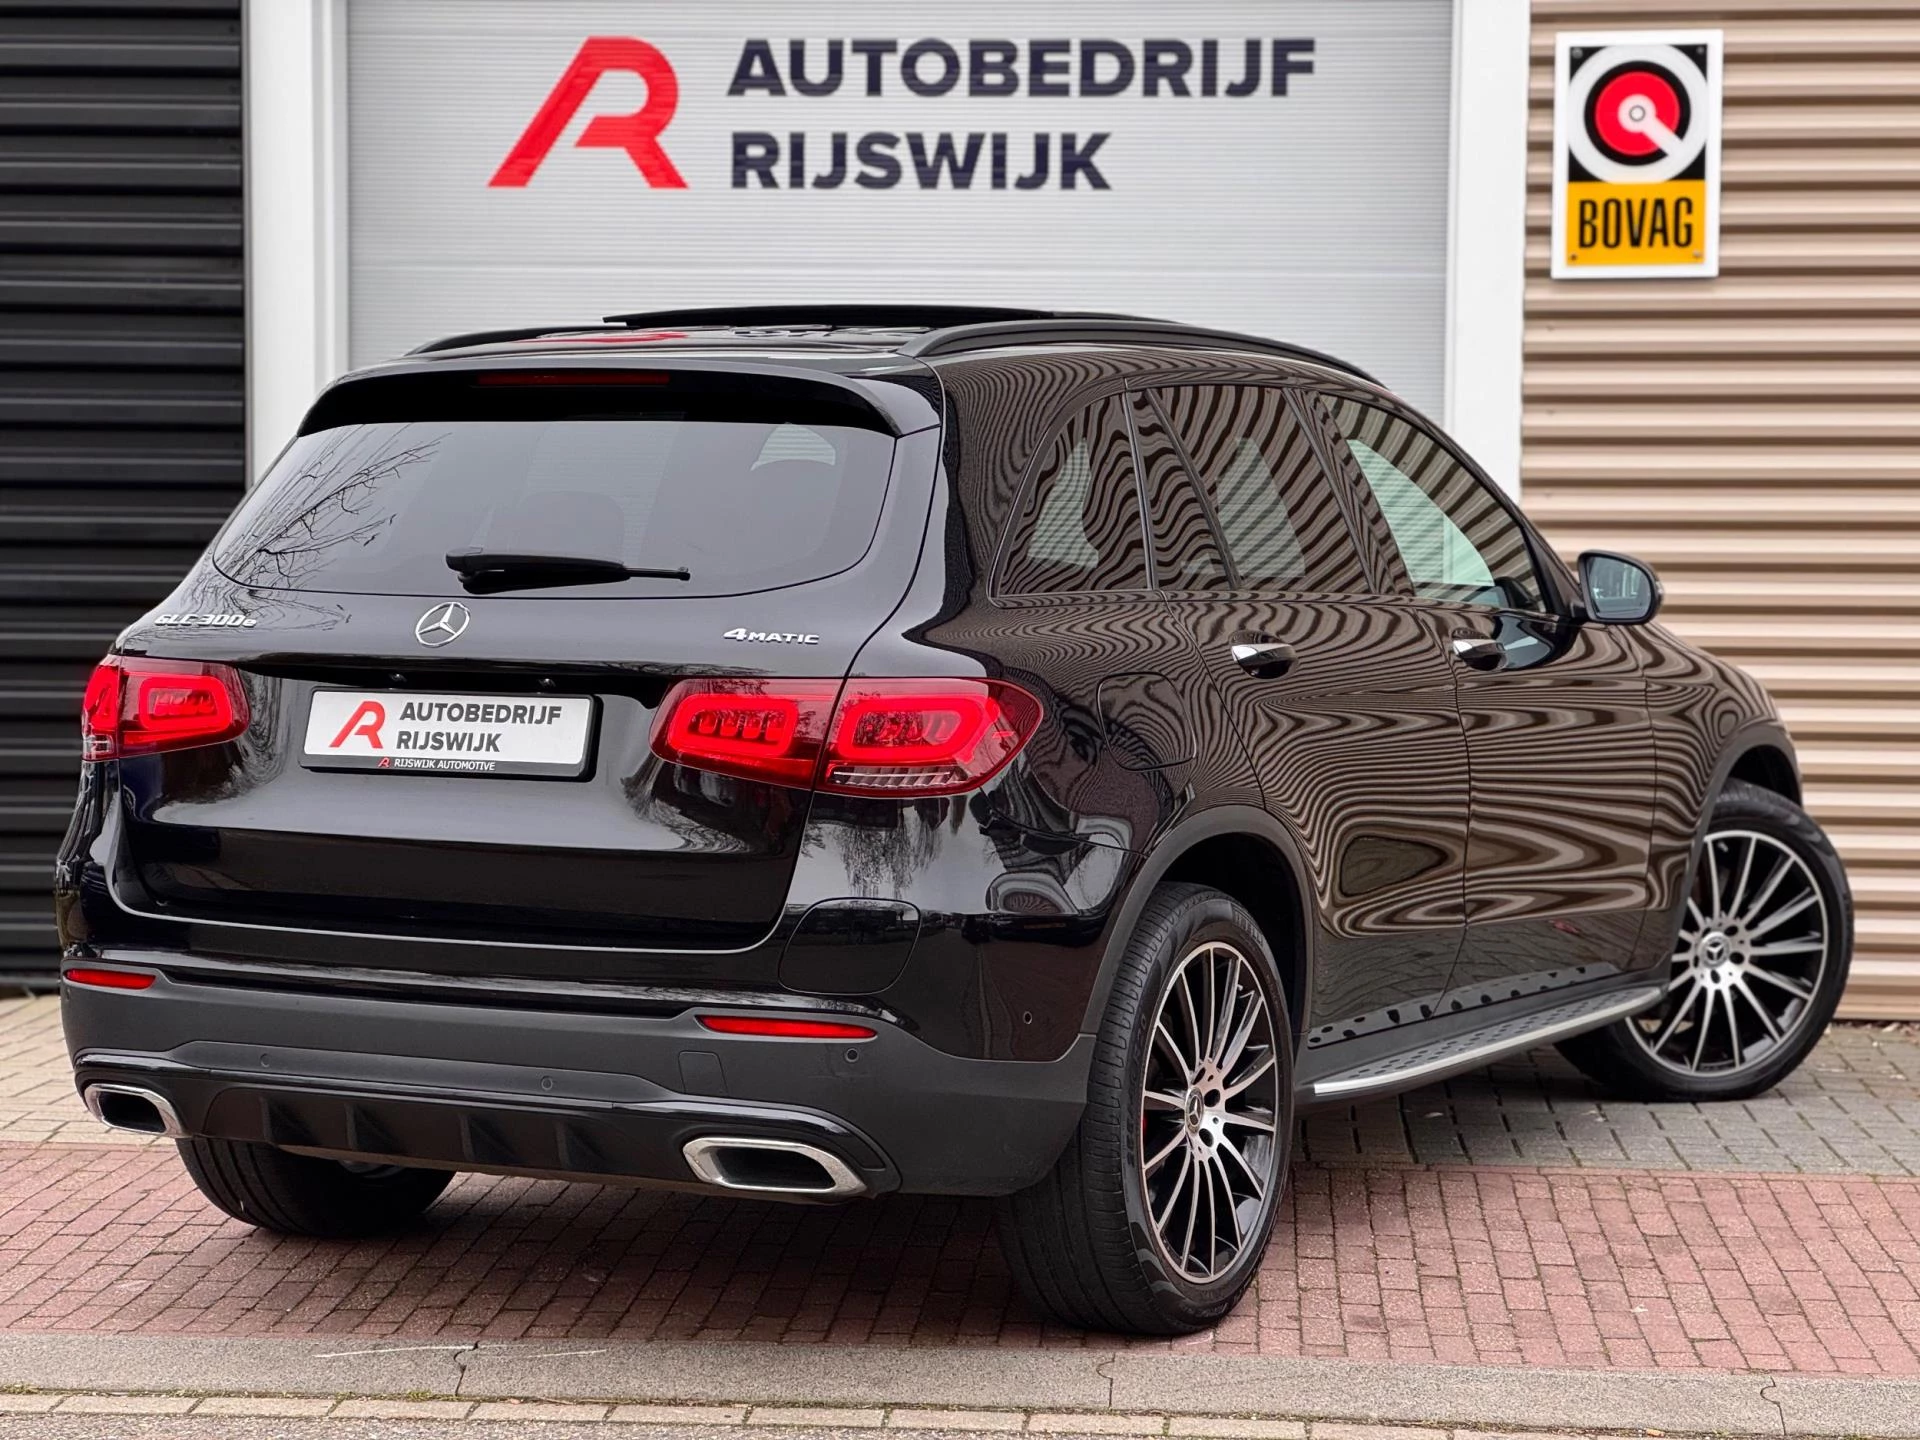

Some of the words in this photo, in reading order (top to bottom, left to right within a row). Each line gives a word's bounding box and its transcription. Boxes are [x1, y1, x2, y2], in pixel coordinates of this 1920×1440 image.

[727, 38, 1315, 98] AUTOBEDRIJF
[730, 131, 1113, 191] RIJSWIJK
[1578, 197, 1693, 249] BOVAG
[154, 613, 199, 627] GLC
[195, 614, 257, 629] 300e
[723, 627, 820, 645] 4MATIC
[399, 702, 562, 725] AUTOBEDRIJF
[396, 730, 502, 753] RIJSWIJK
[393, 758, 436, 769] RIJSWIJK
[436, 760, 496, 772] AUTOMOTIVE
